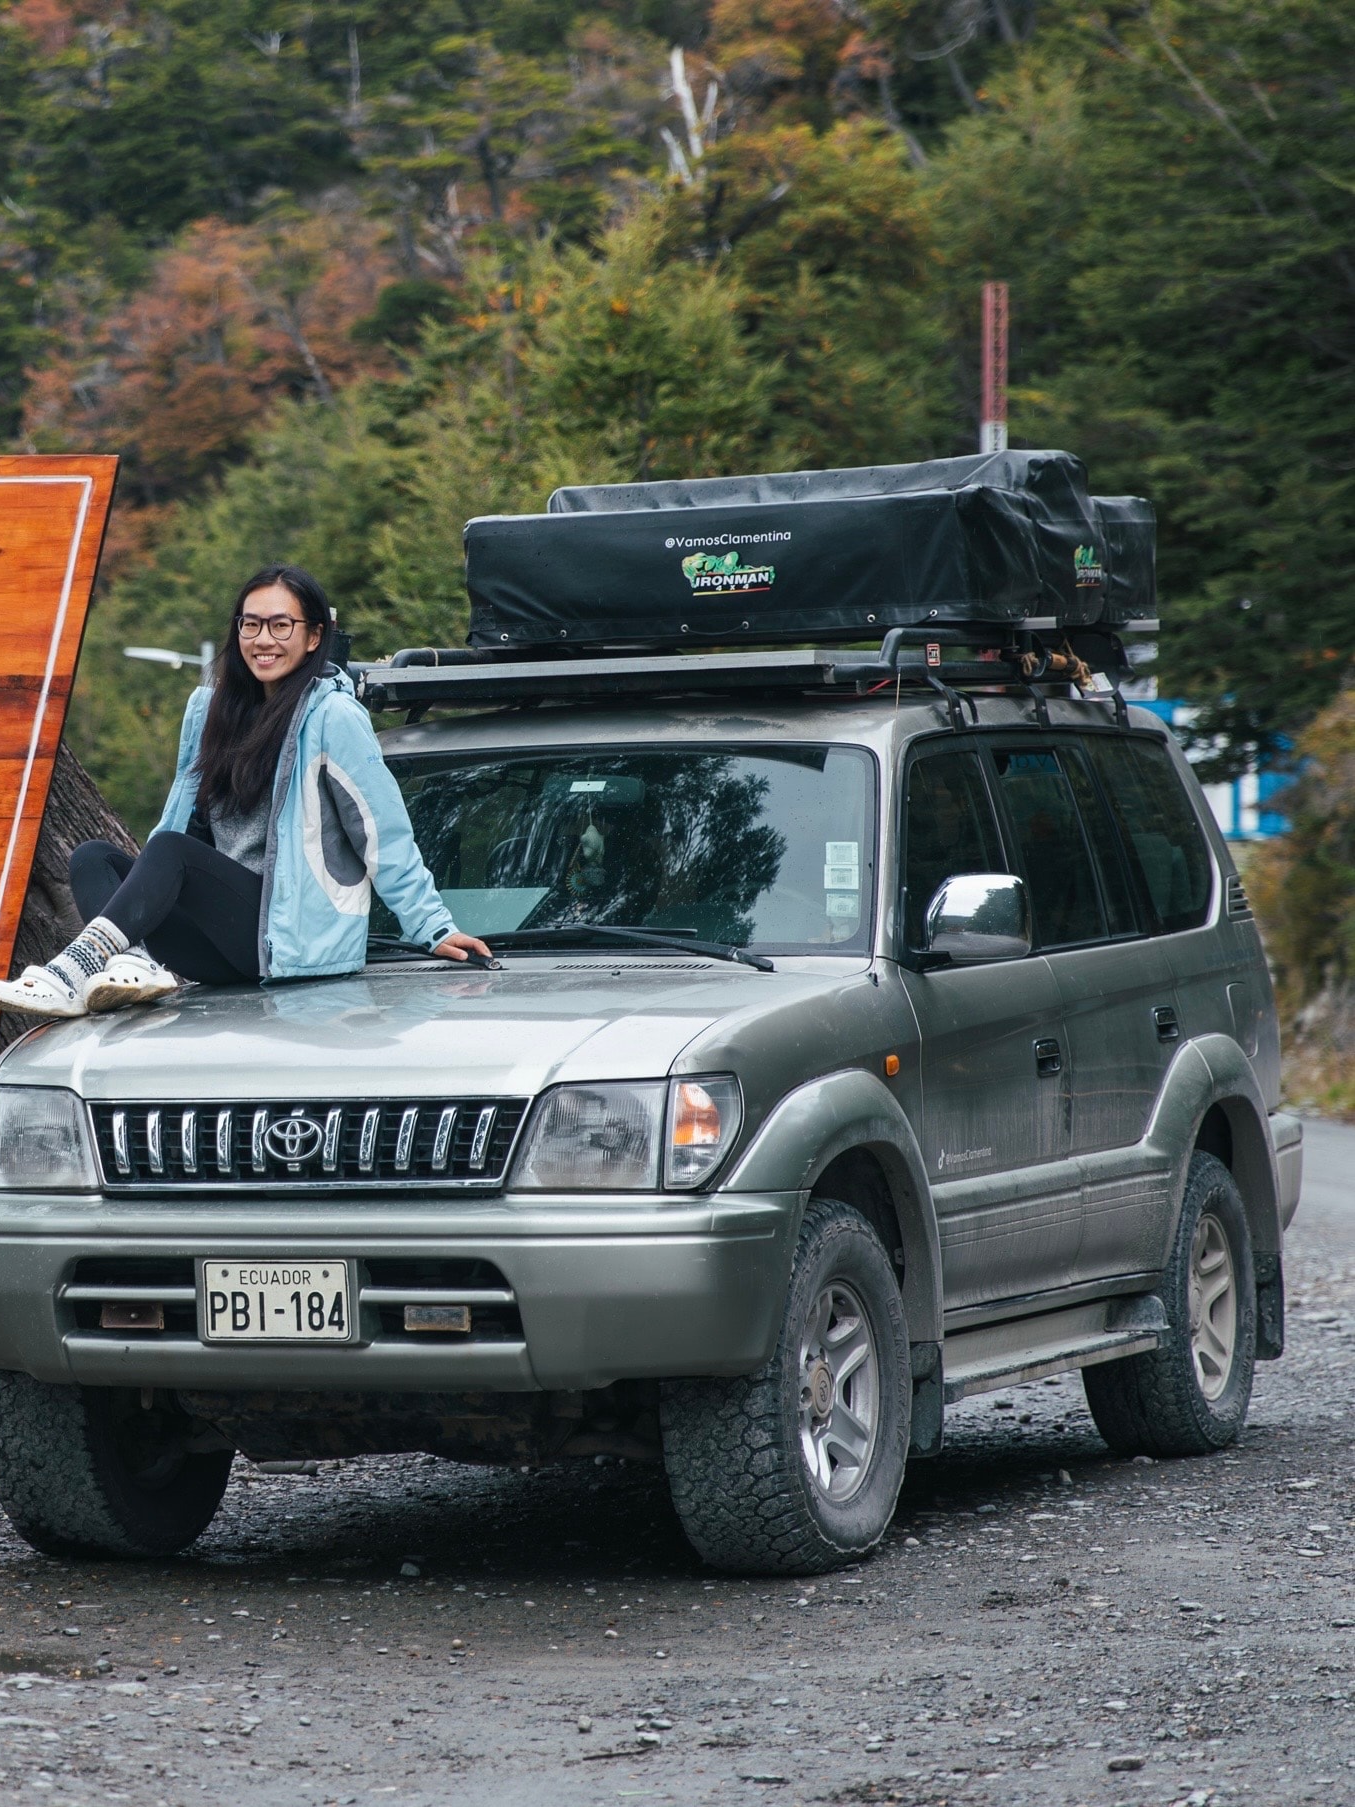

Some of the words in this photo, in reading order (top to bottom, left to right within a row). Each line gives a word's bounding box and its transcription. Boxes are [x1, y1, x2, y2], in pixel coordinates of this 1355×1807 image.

[665, 530, 792, 549] @VamosClamentina
[695, 572, 769, 588] IRONMAN
[239, 1269, 312, 1286] ECUADOR
[209, 1290, 345, 1332] PBI-184
